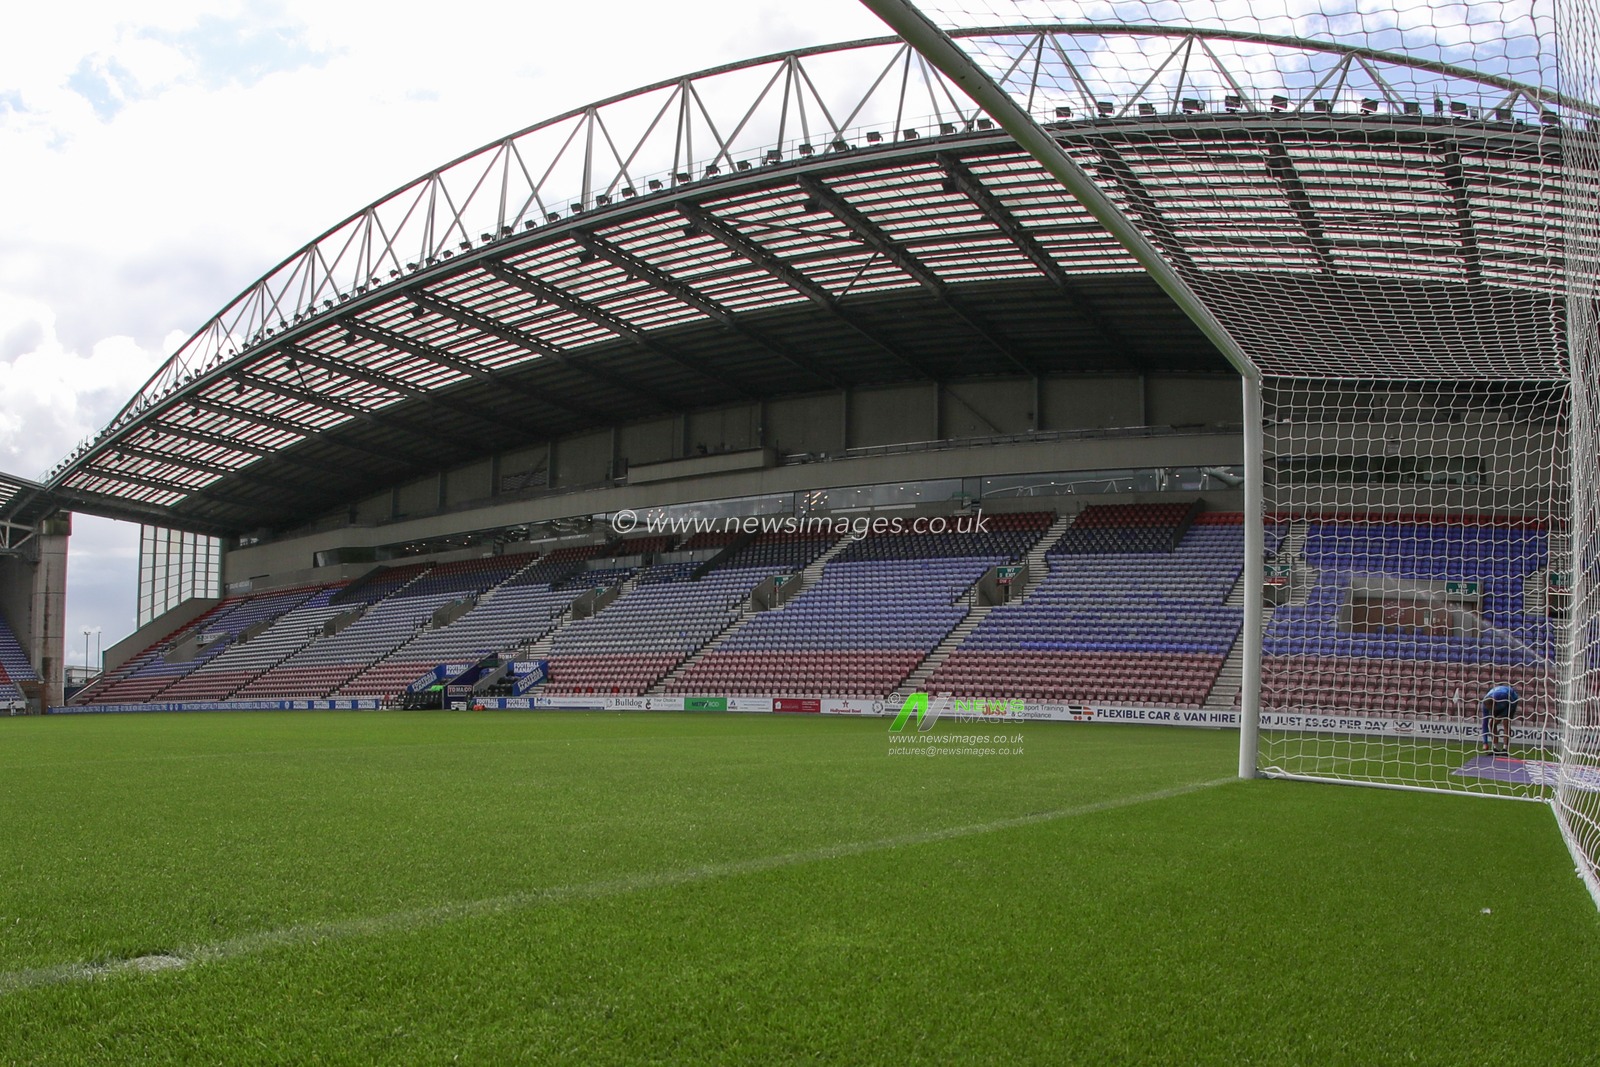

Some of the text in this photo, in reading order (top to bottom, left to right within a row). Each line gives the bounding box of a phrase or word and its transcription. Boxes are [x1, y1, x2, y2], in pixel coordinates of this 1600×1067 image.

[615, 699, 642, 708] Bulldog
[1097, 709, 1145, 720] FLEXIBLE
[1148, 711, 1170, 720] CAR
[1173, 712, 1181, 721] &
[1183, 712, 1207, 722] VAN
[1210, 713, 1236, 722] HIRE
[1274, 716, 1302, 726] JUST
[1340, 720, 1361, 729] PER
[1365, 721, 1388, 731] DAY
